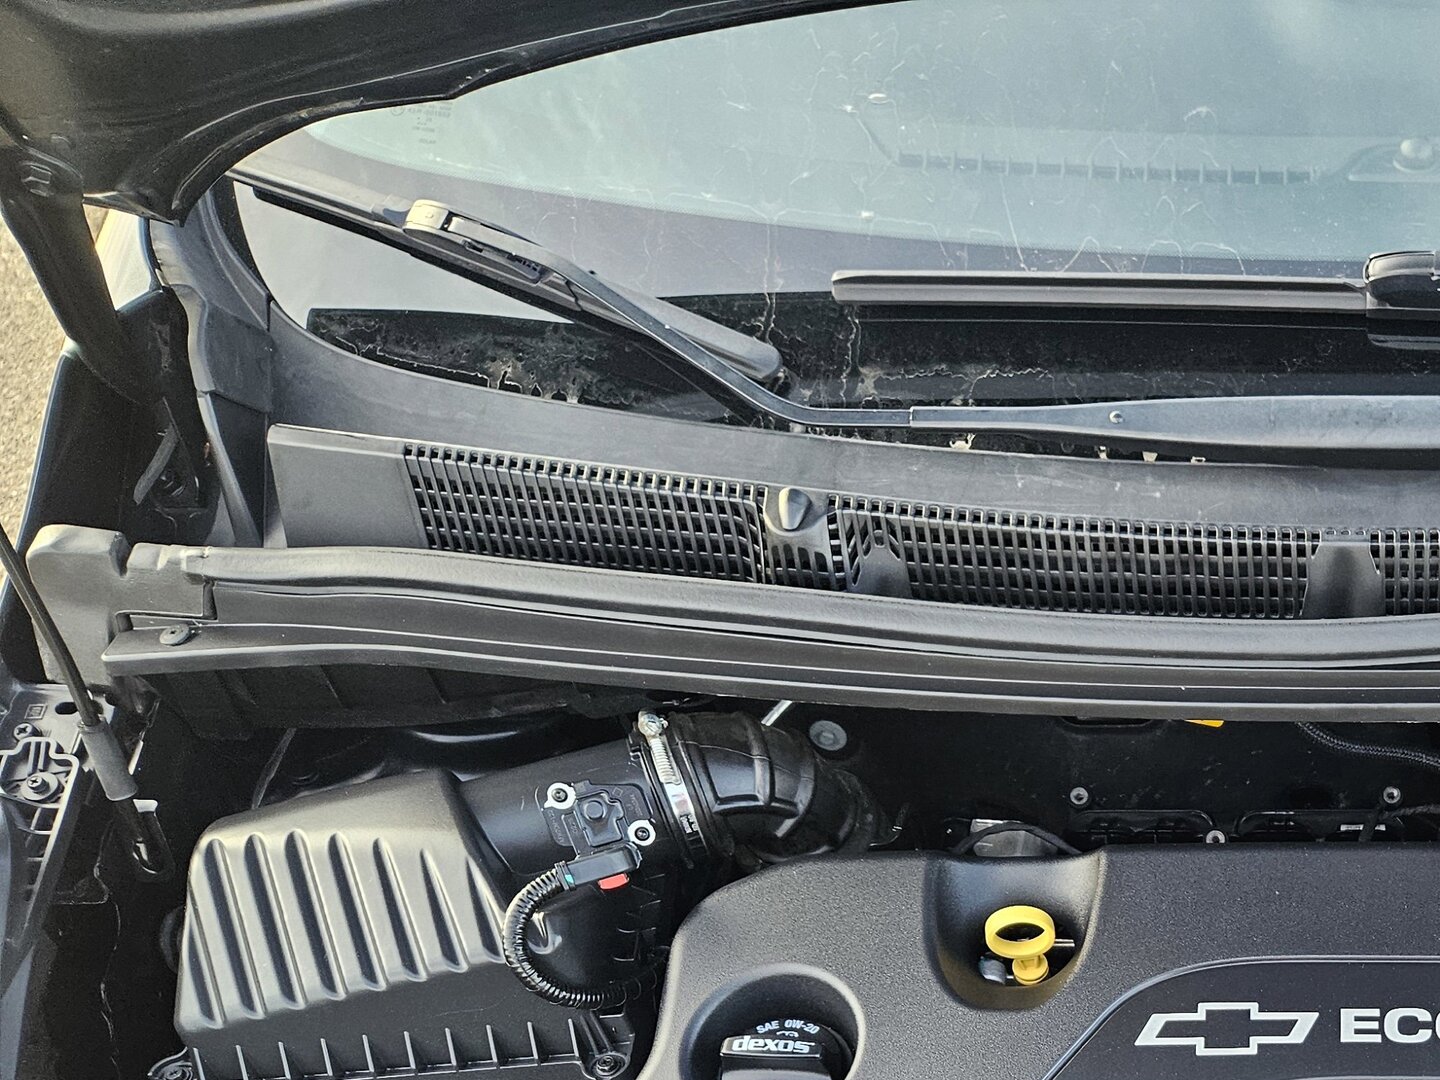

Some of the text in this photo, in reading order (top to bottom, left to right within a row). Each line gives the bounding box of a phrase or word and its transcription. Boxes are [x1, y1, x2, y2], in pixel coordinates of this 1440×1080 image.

[756, 1019, 820, 1035] SAE 0W-20
[731, 1035, 816, 1054] dexos
